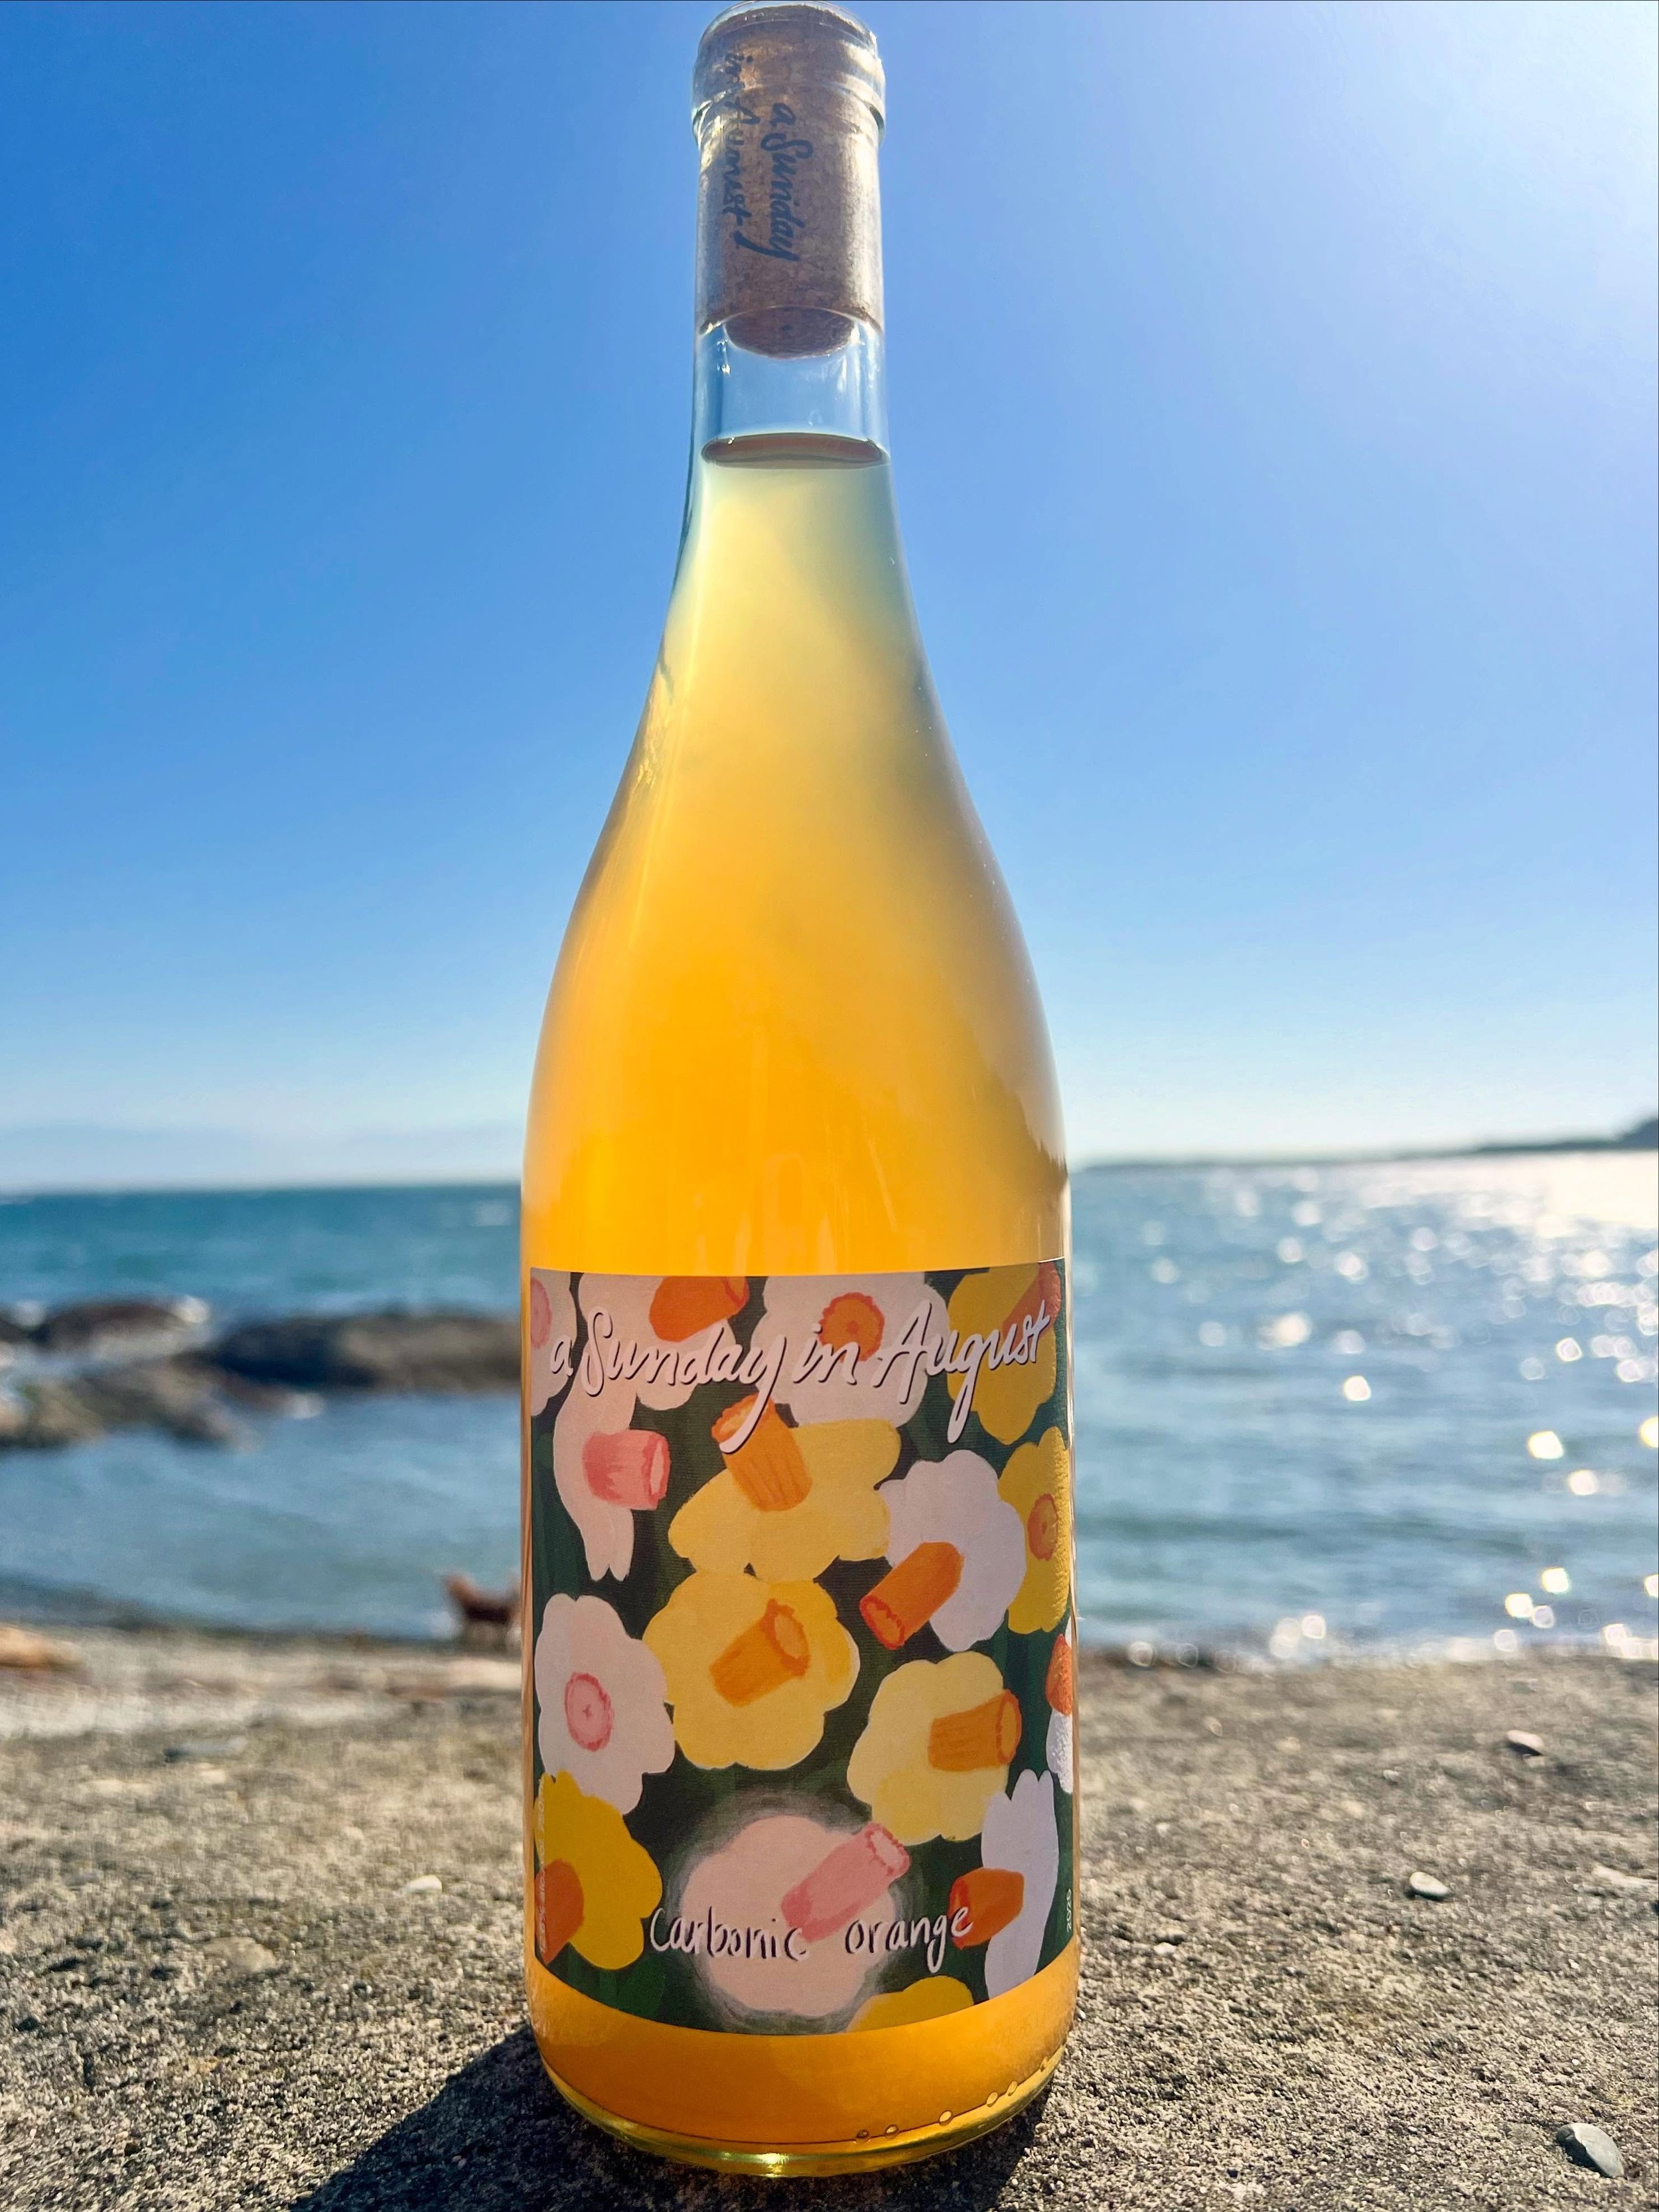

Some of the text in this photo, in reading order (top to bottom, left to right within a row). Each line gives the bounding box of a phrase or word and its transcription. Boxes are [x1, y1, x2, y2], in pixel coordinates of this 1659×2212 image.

[732, 102, 814, 260] a Sunday
[550, 1297, 1050, 1453] a Sunday in August
[650, 1905, 974, 1972] Carbonic orange
